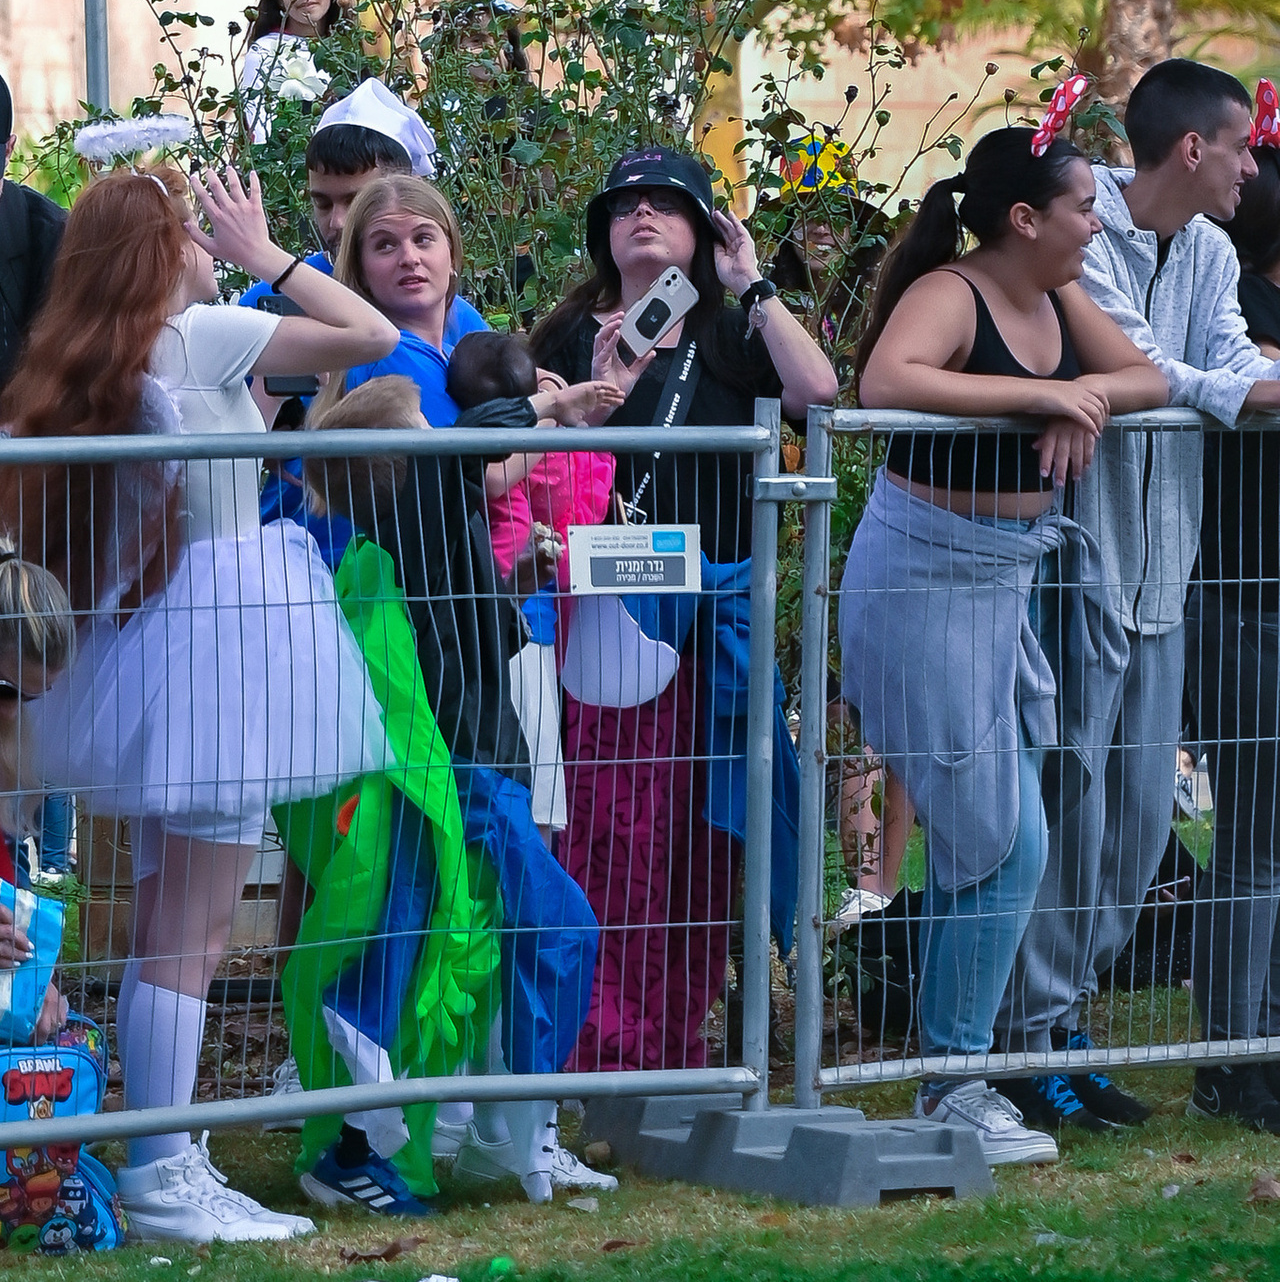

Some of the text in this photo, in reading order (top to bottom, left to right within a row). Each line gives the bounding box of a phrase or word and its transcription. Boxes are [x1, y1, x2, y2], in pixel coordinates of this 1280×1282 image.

[615, 560, 664, 573] גדר זמנית
[616, 573, 636, 582] מכירה
[642, 573, 664, 582] השכרה
[18, 1058, 62, 1074] BRAWL
